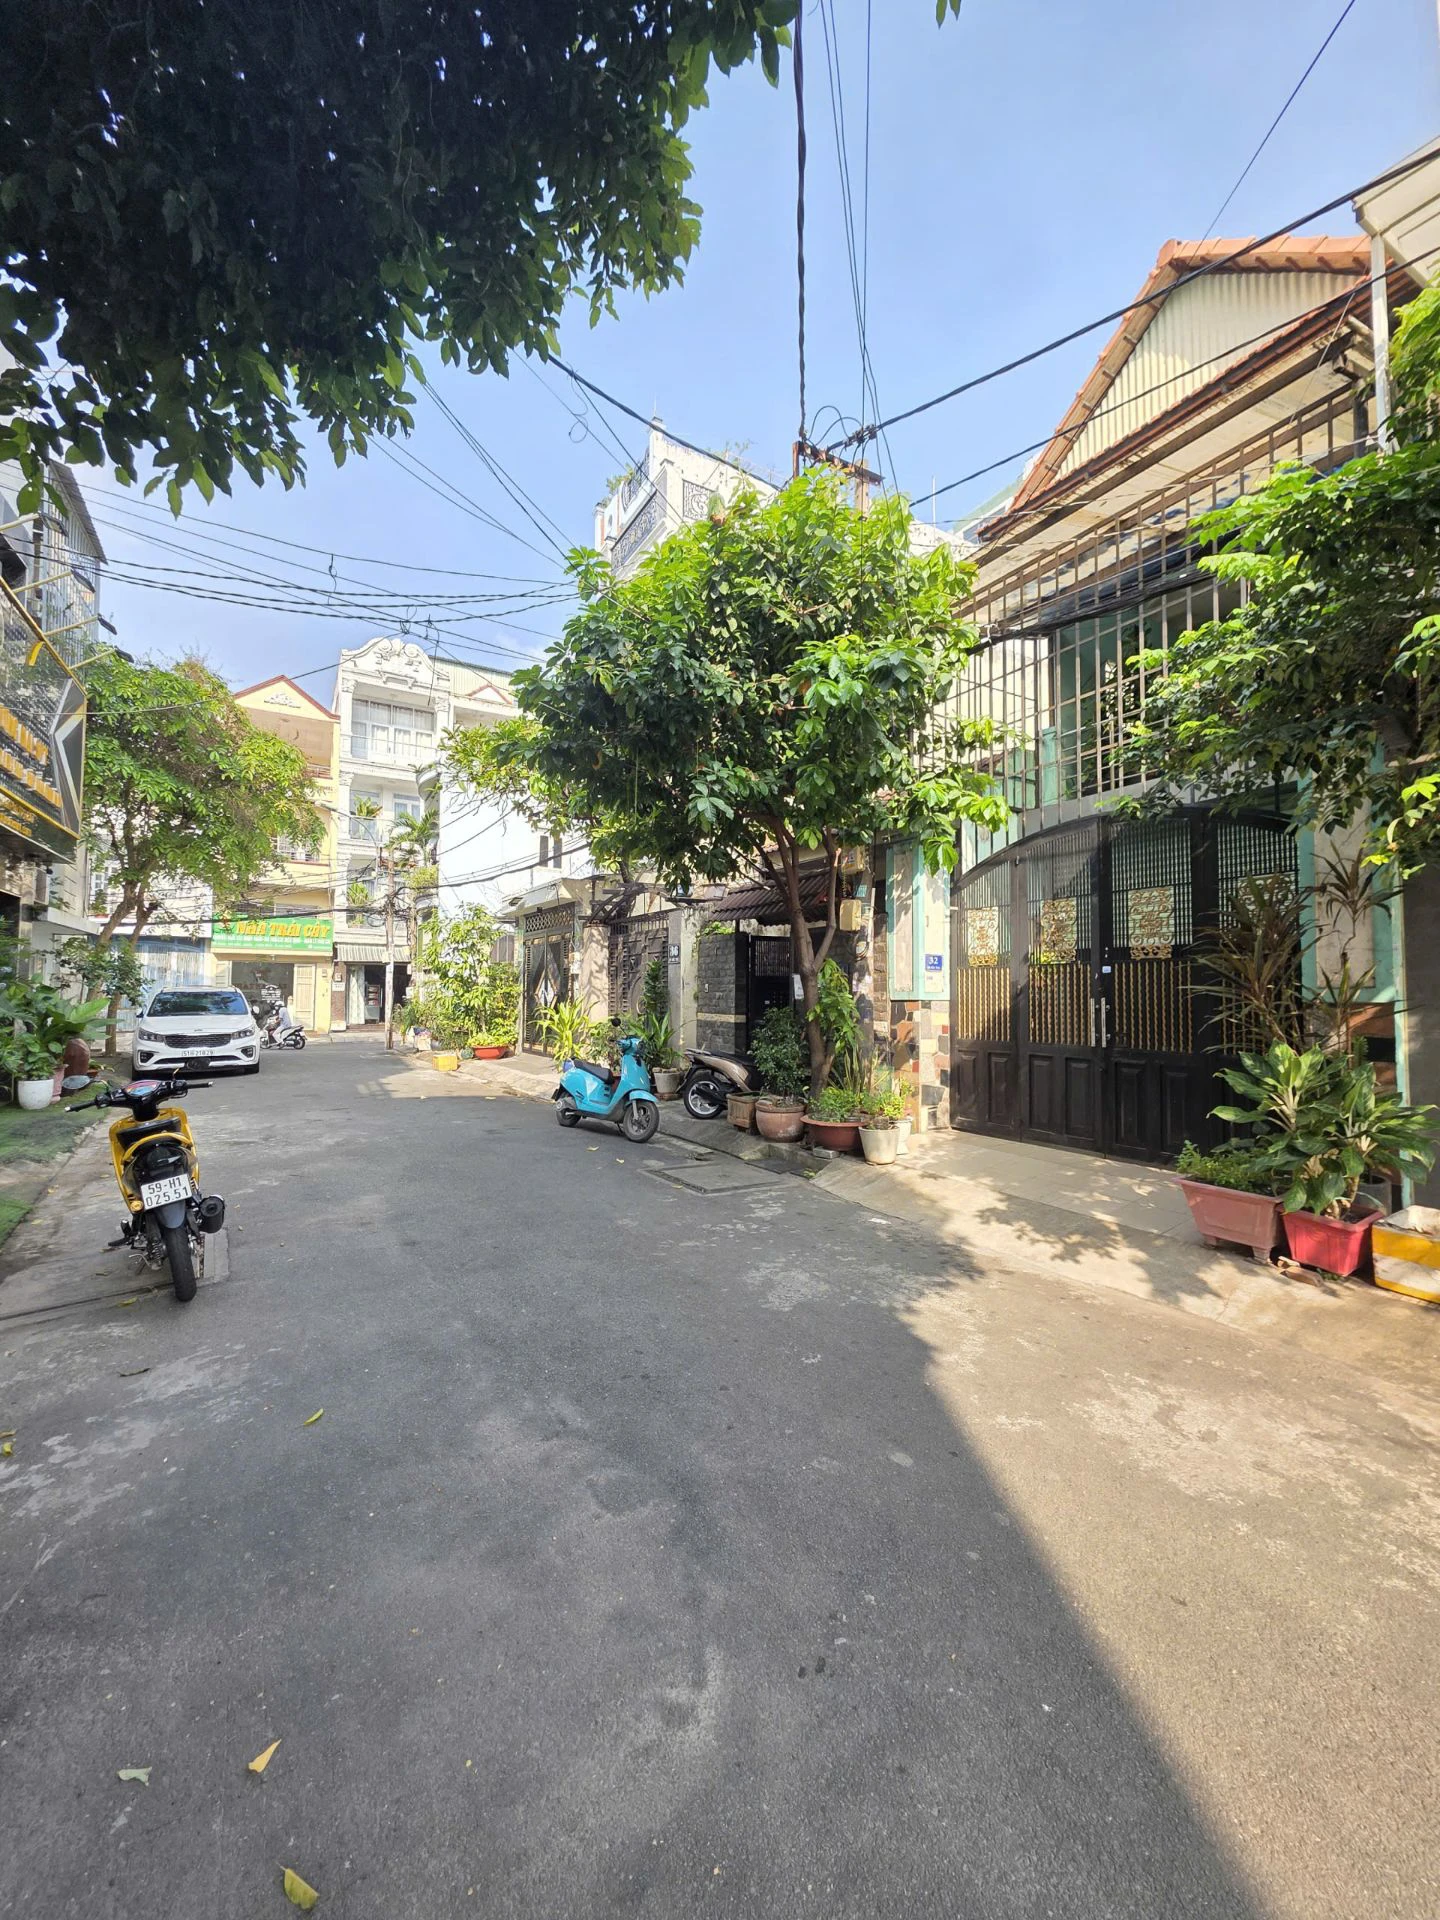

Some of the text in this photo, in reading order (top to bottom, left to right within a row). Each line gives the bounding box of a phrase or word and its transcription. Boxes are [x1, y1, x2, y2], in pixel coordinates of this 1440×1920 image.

[929, 956, 939, 965] 32
[147, 1177, 182, 1195] 59-H1
[145, 1187, 189, 1207] 025.51
